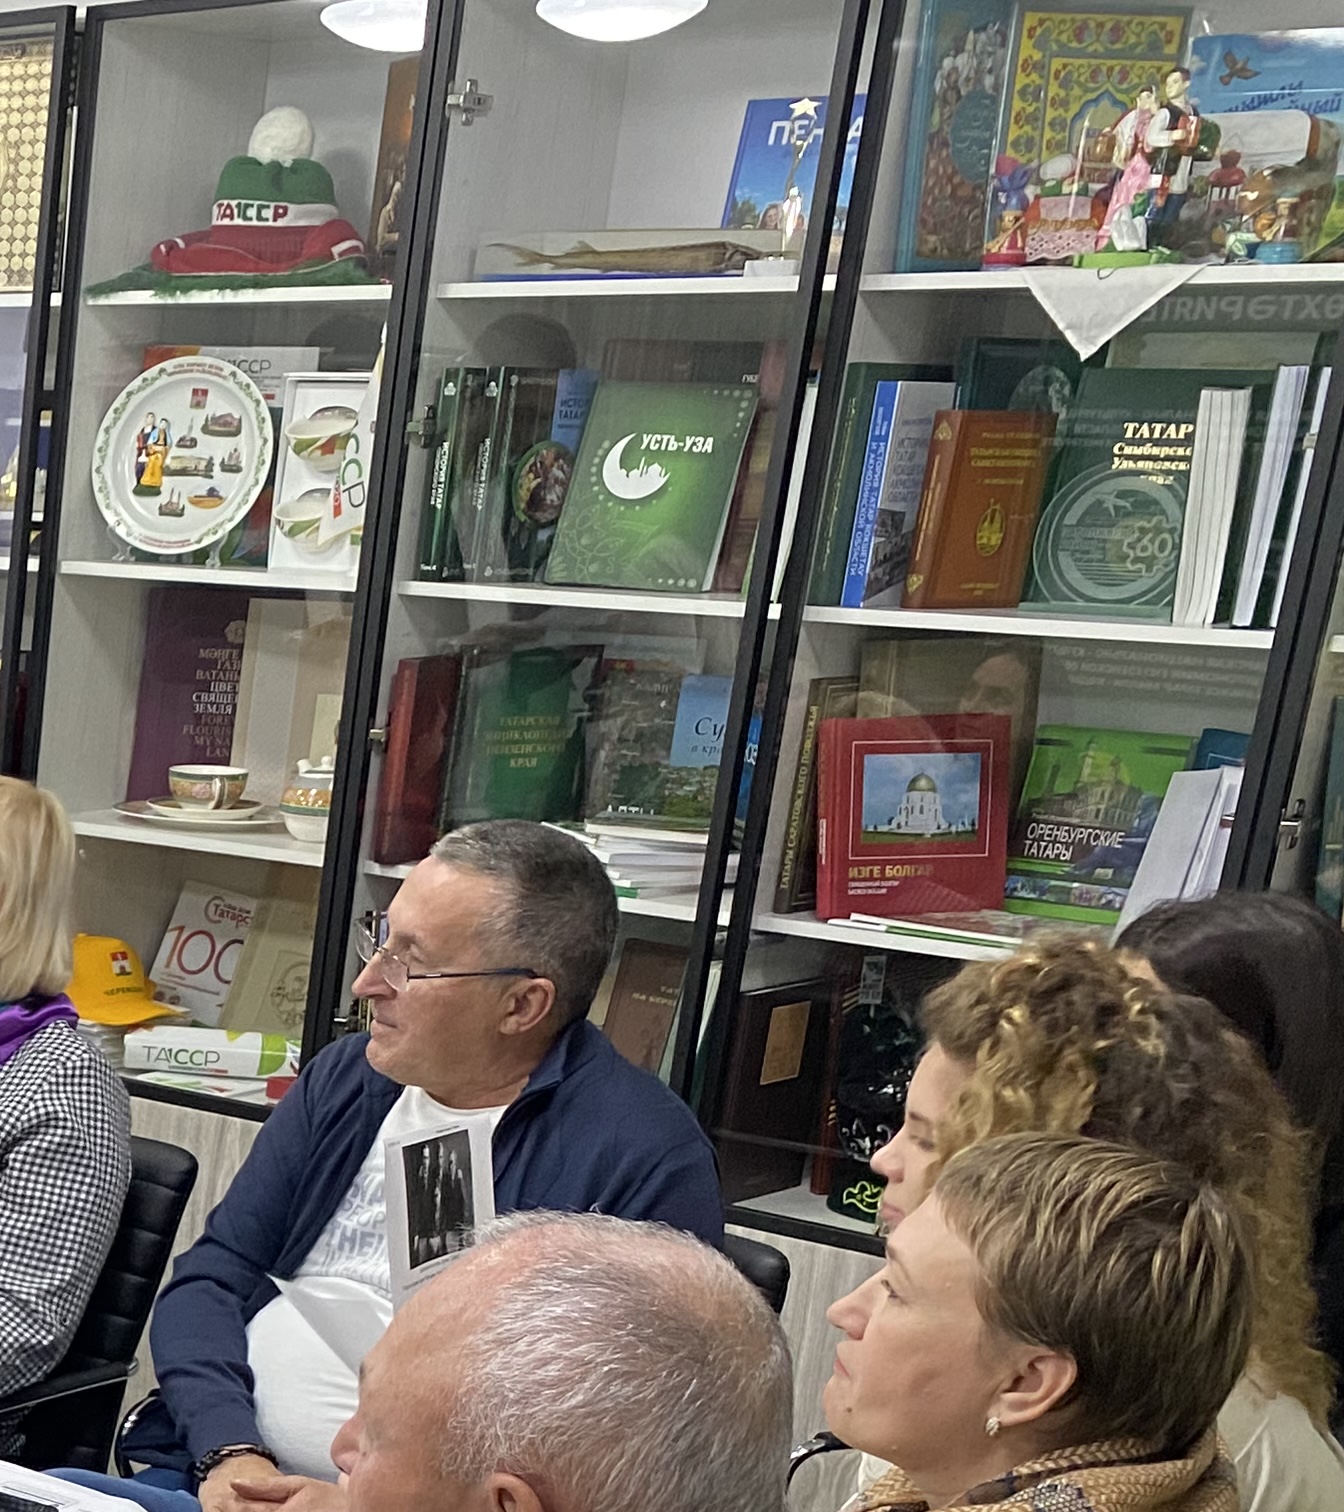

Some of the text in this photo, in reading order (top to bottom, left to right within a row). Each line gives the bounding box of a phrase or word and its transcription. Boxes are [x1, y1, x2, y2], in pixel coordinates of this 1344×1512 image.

[640, 434, 714, 453] УСТЬ-УЗА
[439, 441, 448, 481] ИСТОРИЯ
[480, 437, 490, 480] ИСТОРИЯ
[873, 442, 885, 487] ИСТОРИЯ
[858, 454, 876, 527] АКМОЛИНСКОЙ
[868, 491, 879, 520] ТАТАР
[850, 533, 863, 576] ОБЛАСТИ
[858, 524, 874, 576] КОКШЕТАУ
[1135, 532, 1173, 558] 60
[193, 703, 233, 715] ЗЕМЛЯ
[499, 716, 560, 726] ТАТАРСКАЯ
[510, 757, 537, 768] КРАЯ
[779, 704, 820, 889] ТАТАРЫ САРАТОВСКОГО ПОВОЛЖЬЯ
[1027, 823, 1125, 848] ОРЕНБУРГСКИЕ
[1024, 840, 1073, 860] ТАТАРЫ
[848, 864, 934, 878] ИЗГЕ БОЛГАР
